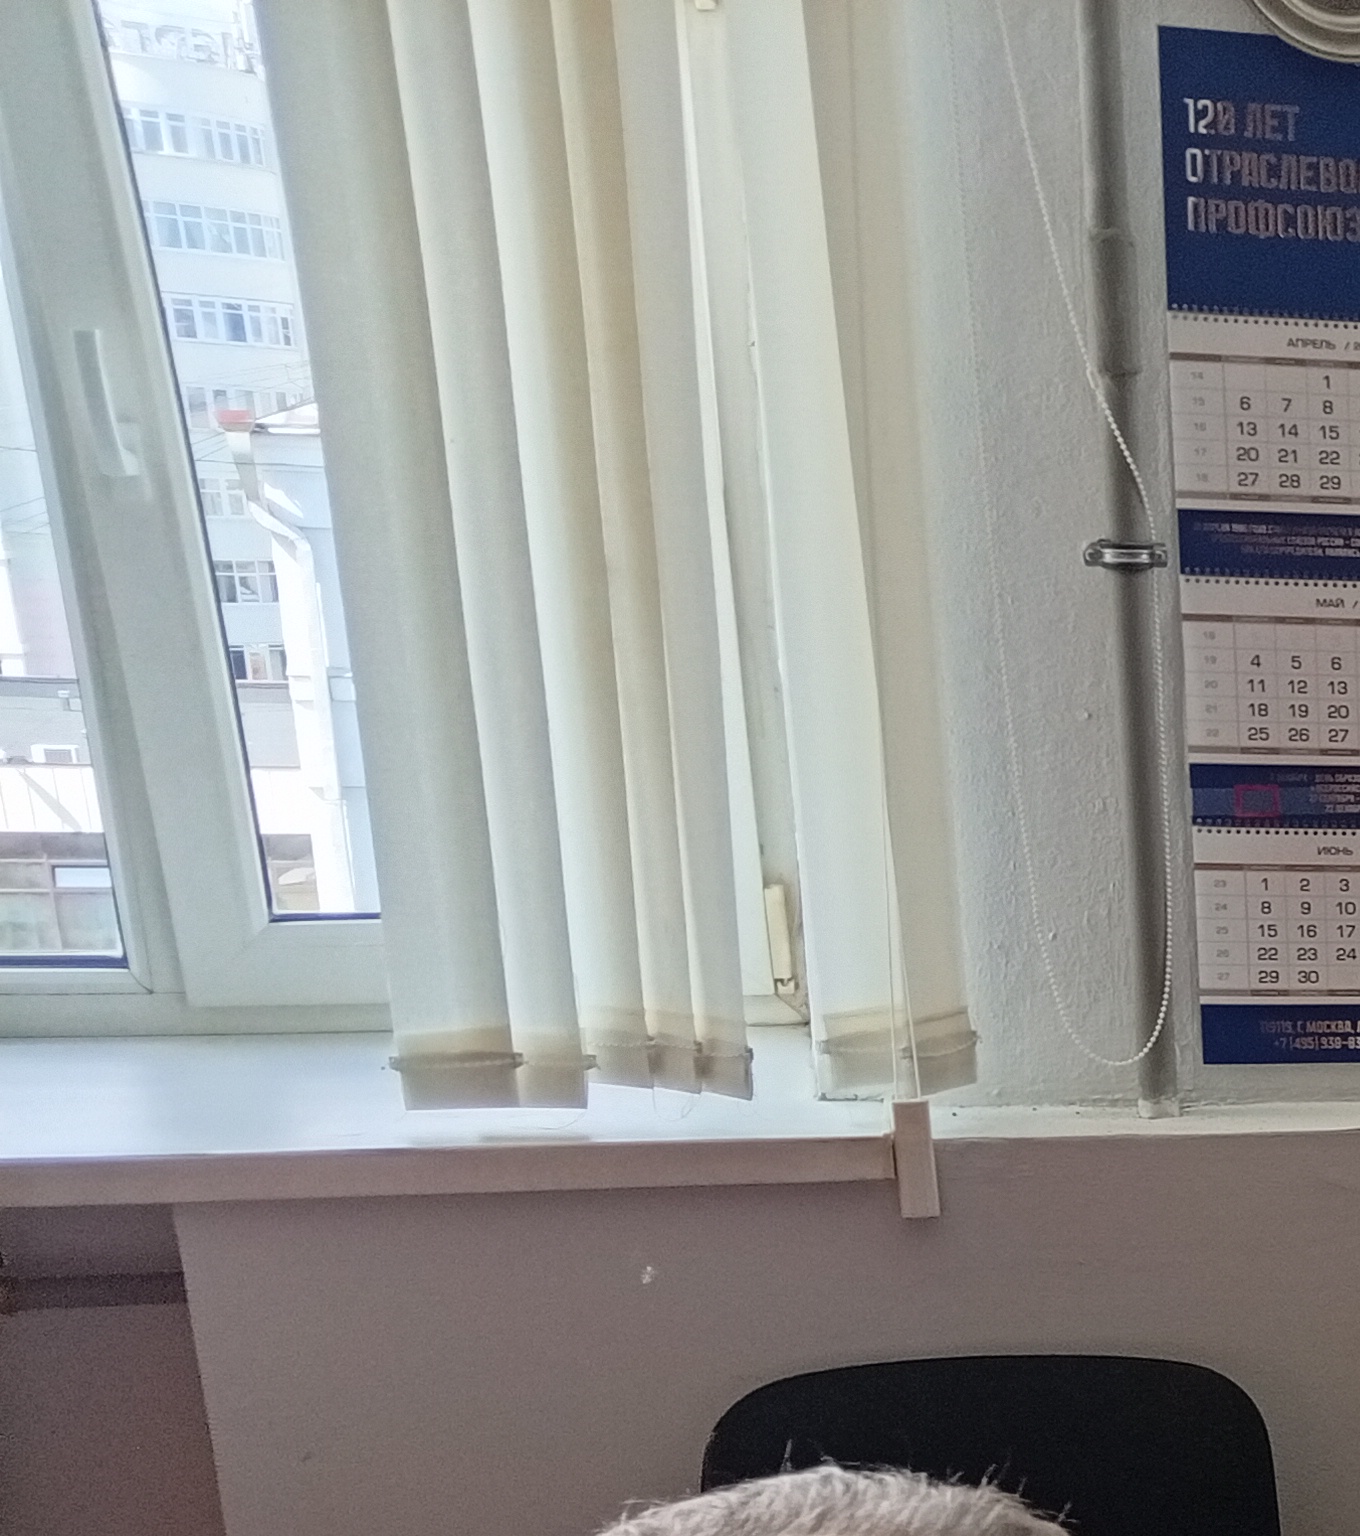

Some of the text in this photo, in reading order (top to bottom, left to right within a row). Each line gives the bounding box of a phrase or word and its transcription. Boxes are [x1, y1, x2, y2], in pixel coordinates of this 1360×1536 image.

[1183, 97, 1300, 141] 120 ЛЕТ
[1286, 337, 1337, 351] АПРЕЛЬ
[1322, 374, 1331, 390] 1
[1239, 395, 1252, 412] 6
[1281, 397, 1293, 413] 7
[1322, 399, 1334, 415] 8
[1236, 421, 1258, 437] 13
[1278, 423, 1299, 438] 14
[1319, 424, 1340, 441] 15
[1235, 446, 1260, 463] 20
[1277, 447, 1298, 464] 21
[1318, 449, 1341, 466] 22
[1237, 471, 1260, 488] 27
[1278, 473, 1301, 489] 28
[1319, 474, 1342, 491] 29
[1315, 597, 1346, 609] МАЙ
[1250, 654, 1262, 668] 4
[1290, 655, 1303, 670] 5
[1330, 656, 1343, 671] 6
[1247, 678, 1266, 693] 11
[1287, 679, 1308, 695] 12
[1327, 680, 1348, 696] 13
[1248, 702, 1269, 718] 18
[1288, 703, 1309, 719] 19
[1327, 704, 1350, 720] 20
[1247, 726, 1270, 742] 25
[1287, 727, 1310, 743] 26
[1327, 728, 1350, 743] 27
[1317, 846, 1354, 857] ИЮНЬ
[1261, 877, 1269, 892] 1
[1299, 877, 1311, 893] 2
[1338, 878, 1350, 893] 3
[1260, 900, 1272, 915] 8
[1300, 901, 1312, 916] 9
[1335, 901, 1357, 916] 10
[1257, 923, 1279, 938] 15
[1297, 923, 1318, 939] 16
[1336, 924, 1356, 939] 17
[1256, 946, 1279, 962] 22
[1296, 946, 1319, 962] 23
[1335, 947, 1358, 962] 24
[1257, 969, 1280, 984] 29
[1297, 969, 1320, 985] 30
[1306, 1019, 1355, 1034] МОСКВА,
